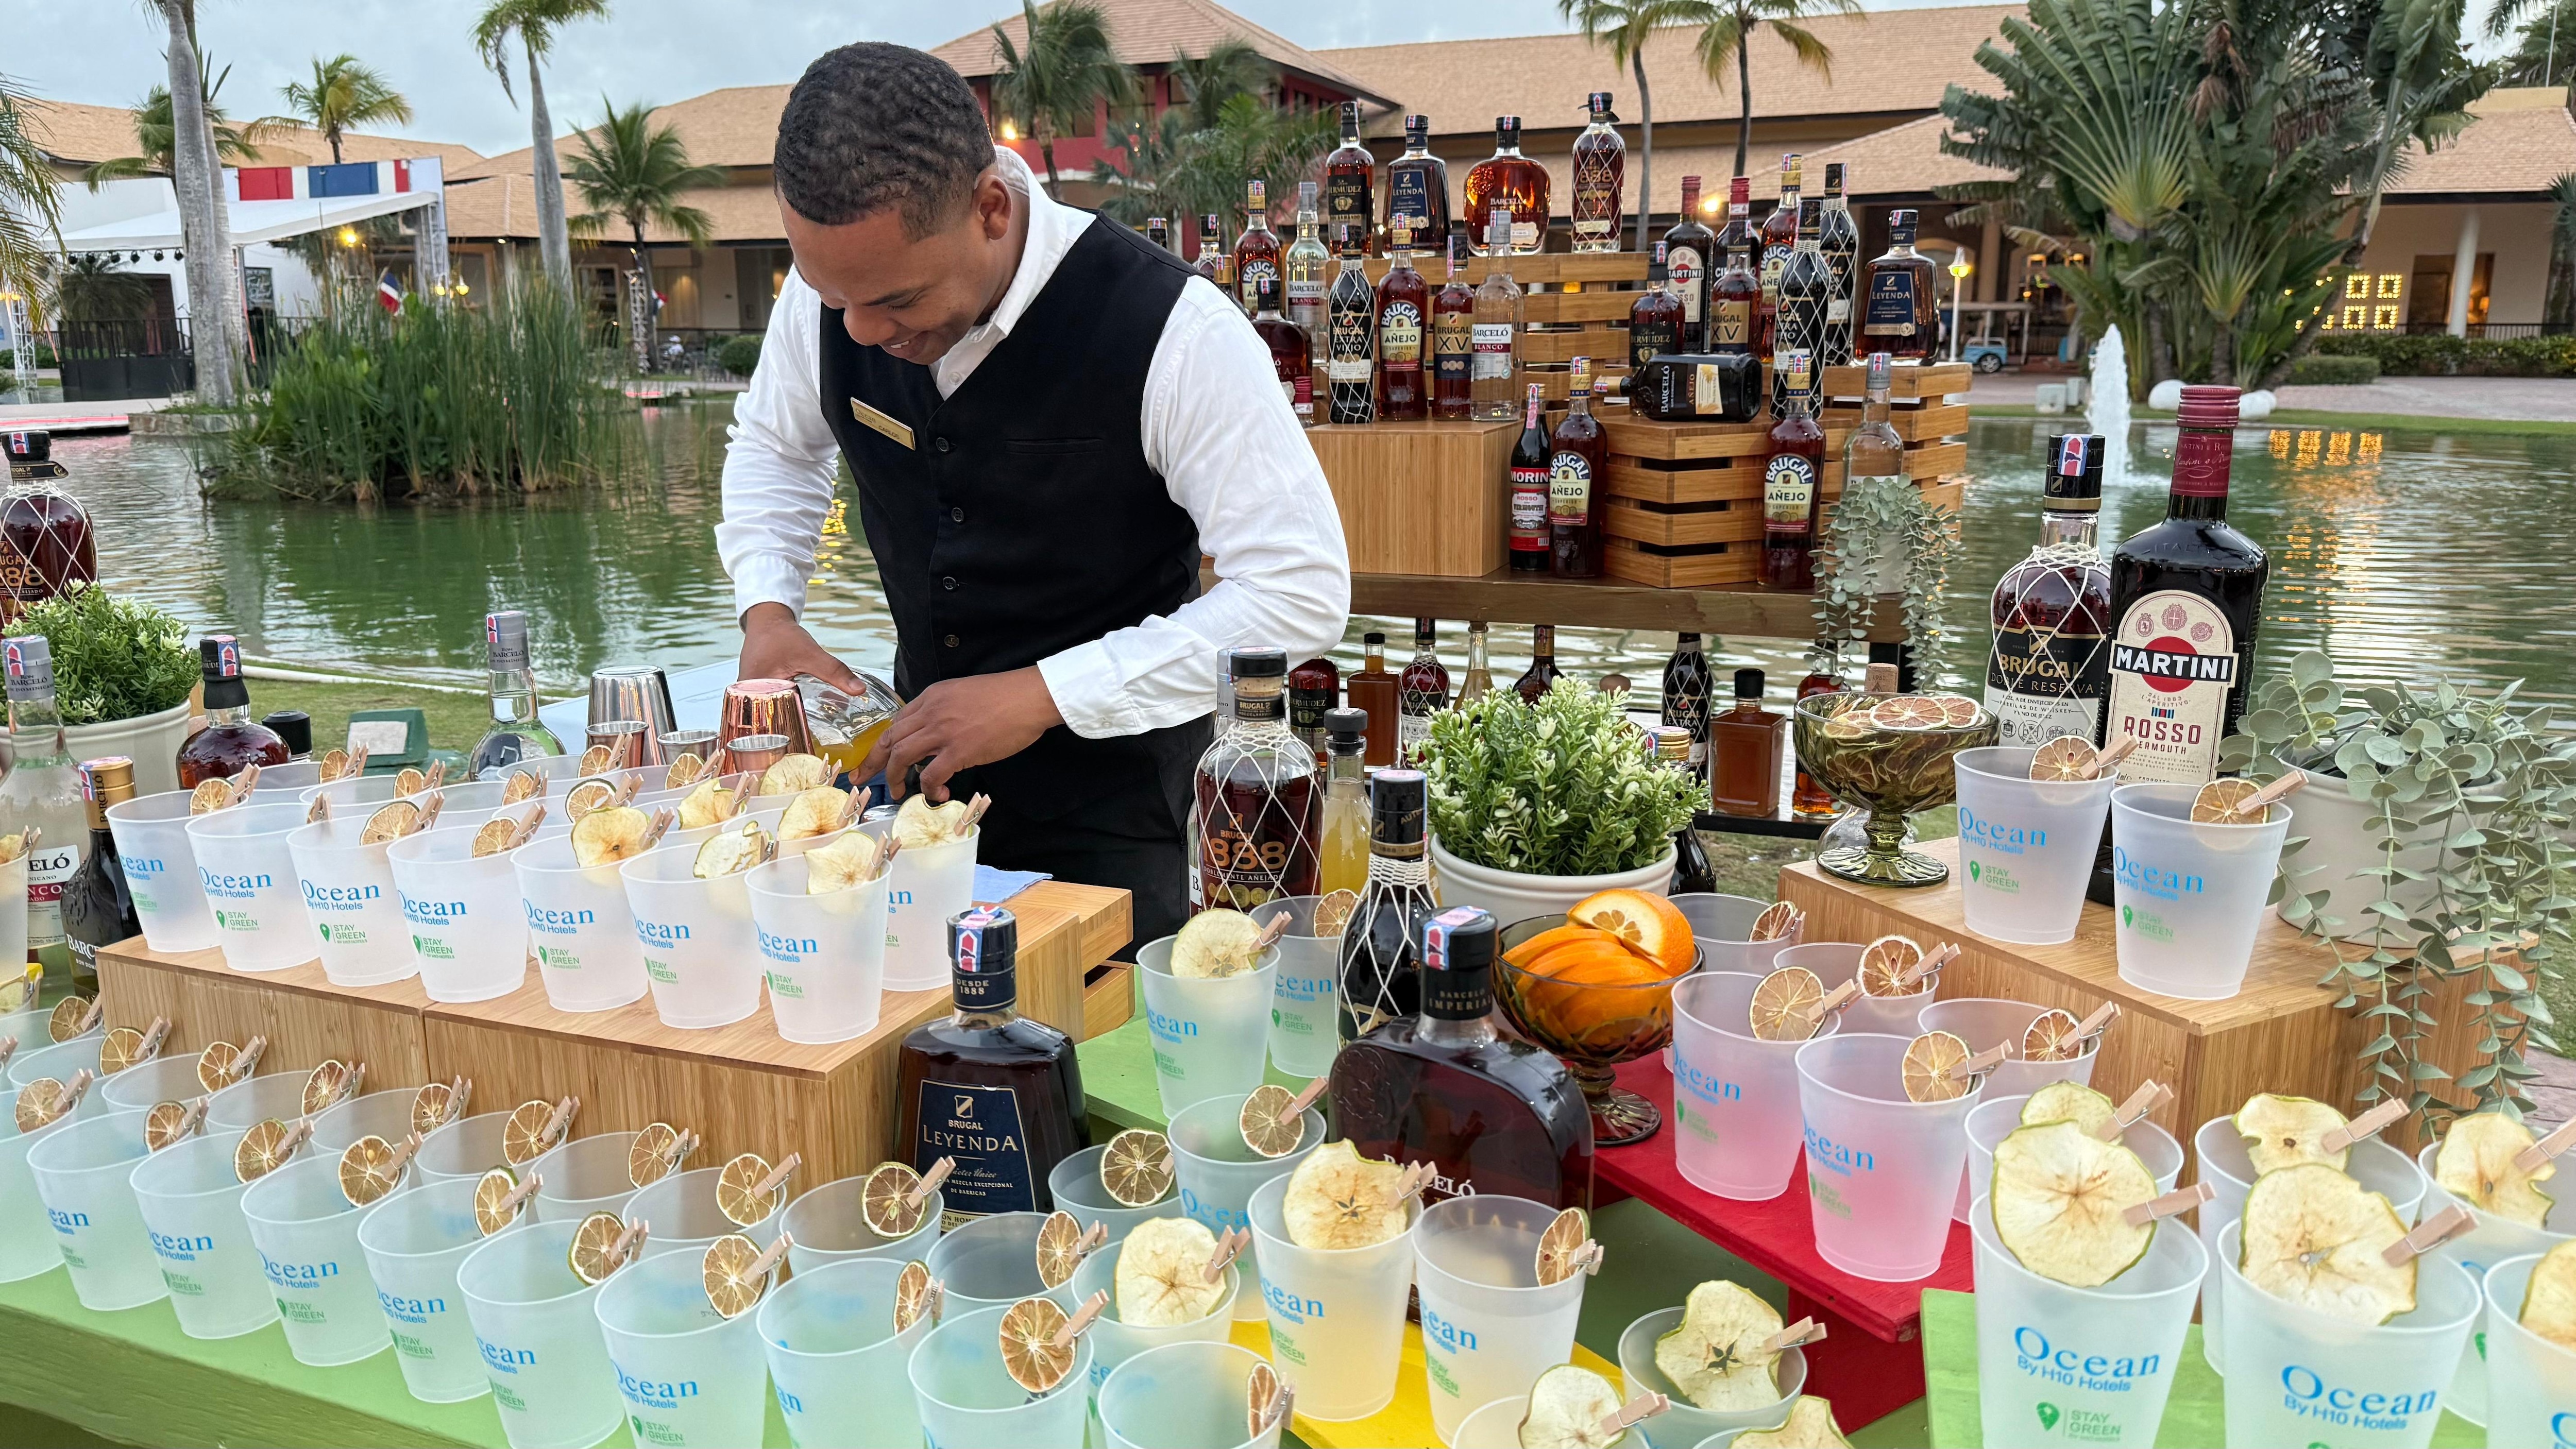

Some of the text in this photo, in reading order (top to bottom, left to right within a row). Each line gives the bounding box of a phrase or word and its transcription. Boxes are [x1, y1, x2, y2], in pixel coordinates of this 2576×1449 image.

[1760, 244, 1795, 270] BRUGA
[1762, 276, 1780, 287] AÑE
[1381, 303, 1421, 327] BRUGAL
[1437, 326, 1470, 334] BRUGAL
[1472, 328, 1508, 337] BARCELÓ
[1385, 334, 1416, 343] AÑEJO
[1661, 365, 1670, 413] BARCELÓ
[1550, 453, 1589, 479] BRUGAL
[1766, 457, 1809, 483] BRUGAL
[1552, 485, 1583, 496] AÑEJO
[1768, 490, 1806, 501] AÑEJO
[1999, 653, 2085, 678] BRUGAL
[2115, 646, 2230, 681] MARTINI
[2124, 715, 2201, 744] ROSSO
[2139, 741, 2186, 755] ERMOUTH
[1959, 806, 2047, 847] Ocean
[28, 853, 70, 872] ELÓ
[120, 855, 164, 872] cean
[1985, 865, 2010, 877] STAY
[2114, 846, 2205, 894] Ocean
[198, 866, 273, 889] Ocean
[1986, 876, 2020, 889] GREEN
[28, 885, 62, 895] NCO
[225, 889, 255, 898] Hotels
[301, 879, 381, 901] Ocean
[331, 901, 363, 911] Hotels
[522, 898, 595, 925] Ocean
[227, 911, 247, 919] STAY
[420, 915, 449, 926] Hotels
[230, 918, 258, 928] GREEN
[334, 924, 354, 932] STAY
[548, 924, 577, 934] Hotels
[336, 931, 366, 940] GREEN
[422, 937, 442, 946] STAY
[648, 937, 674, 949] Hotels
[425, 945, 453, 954] GREEN
[549, 948, 569, 956] STAY
[551, 956, 580, 964] GREEN
[773, 950, 801, 963] Hotels
[651, 960, 667, 969] STAY
[653, 968, 677, 979] GREEN
[775, 974, 792, 984] STAY
[776, 982, 802, 993] GREEN
[957, 979, 990, 987] DESDE
[1275, 974, 1332, 993] cean
[959, 986, 985, 995] 1888
[1148, 1009, 1198, 1036] cean
[1284, 1013, 1303, 1021] STAY
[1285, 1021, 1313, 1031] GREEN
[948, 1119, 984, 1130] BRUGAL
[923, 1124, 1020, 1151] LEYENDA
[1804, 1120, 1874, 1171] cean
[1182, 1188, 1249, 1225] Ocea
[48, 1208, 90, 1226] ean
[150, 1232, 214, 1251] cean
[165, 1247, 195, 1262] Hotels
[285, 1277, 320, 1289] Hotels
[1262, 1278, 1325, 1317] cean
[289, 1302, 311, 1311] STAY
[292, 1310, 325, 1319] GREEN
[395, 1311, 427, 1324] Hotels
[401, 1335, 420, 1345] STAY
[402, 1344, 433, 1355] GREEN
[477, 1337, 537, 1365] cean
[2014, 1326, 2160, 1378] Ocean
[2018, 1354, 2132, 1391] By H10 Hotels
[2281, 1365, 2437, 1416] Ocean
[641, 1397, 678, 1409] Hotels
[2071, 1409, 2110, 1423] STAY
[2284, 1394, 2408, 1430] By H10 Hotels
[646, 1422, 670, 1432] STAY
[2070, 1422, 2121, 1436] GREEN
[648, 1430, 683, 1442] GREEN
